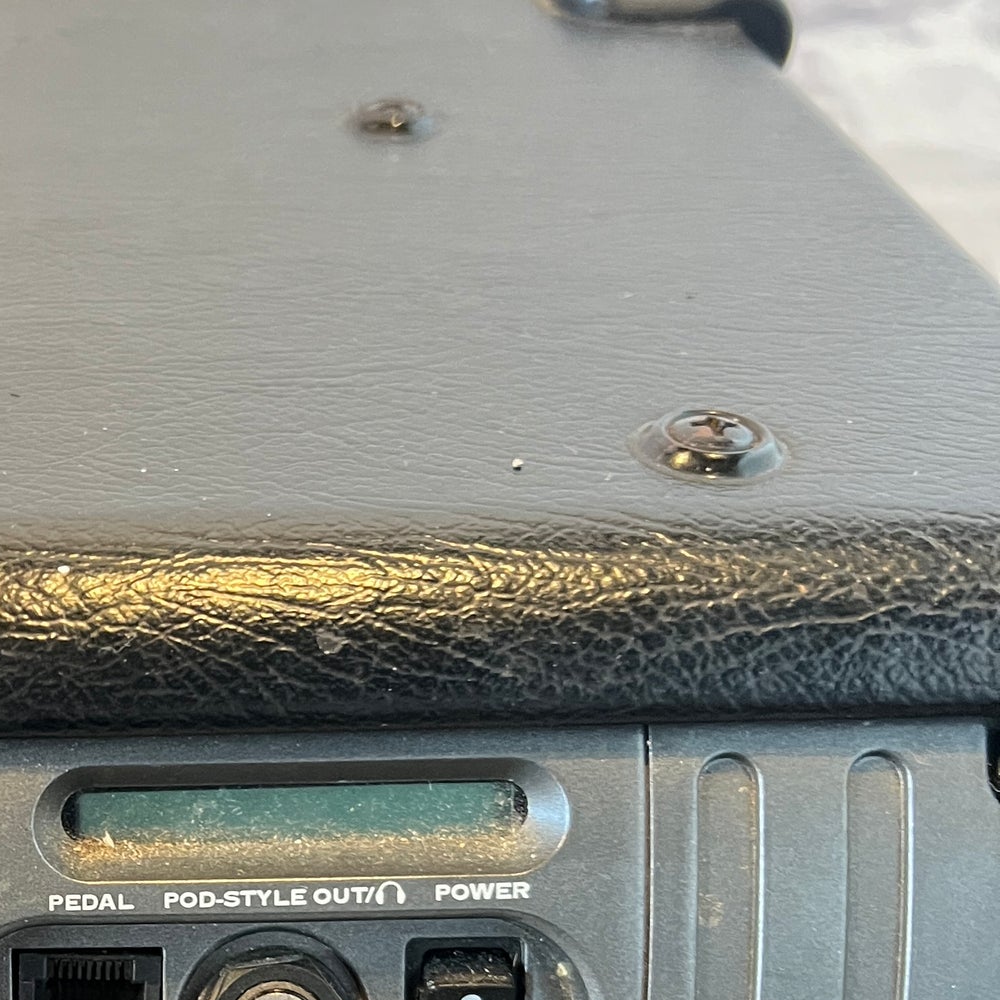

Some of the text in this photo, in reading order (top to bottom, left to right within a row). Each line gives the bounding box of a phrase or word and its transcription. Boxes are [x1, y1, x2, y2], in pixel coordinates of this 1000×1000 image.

[163, 889, 307, 909] POD-STYLE
[434, 881, 531, 902] POWER
[48, 893, 135, 912] PEDAL
